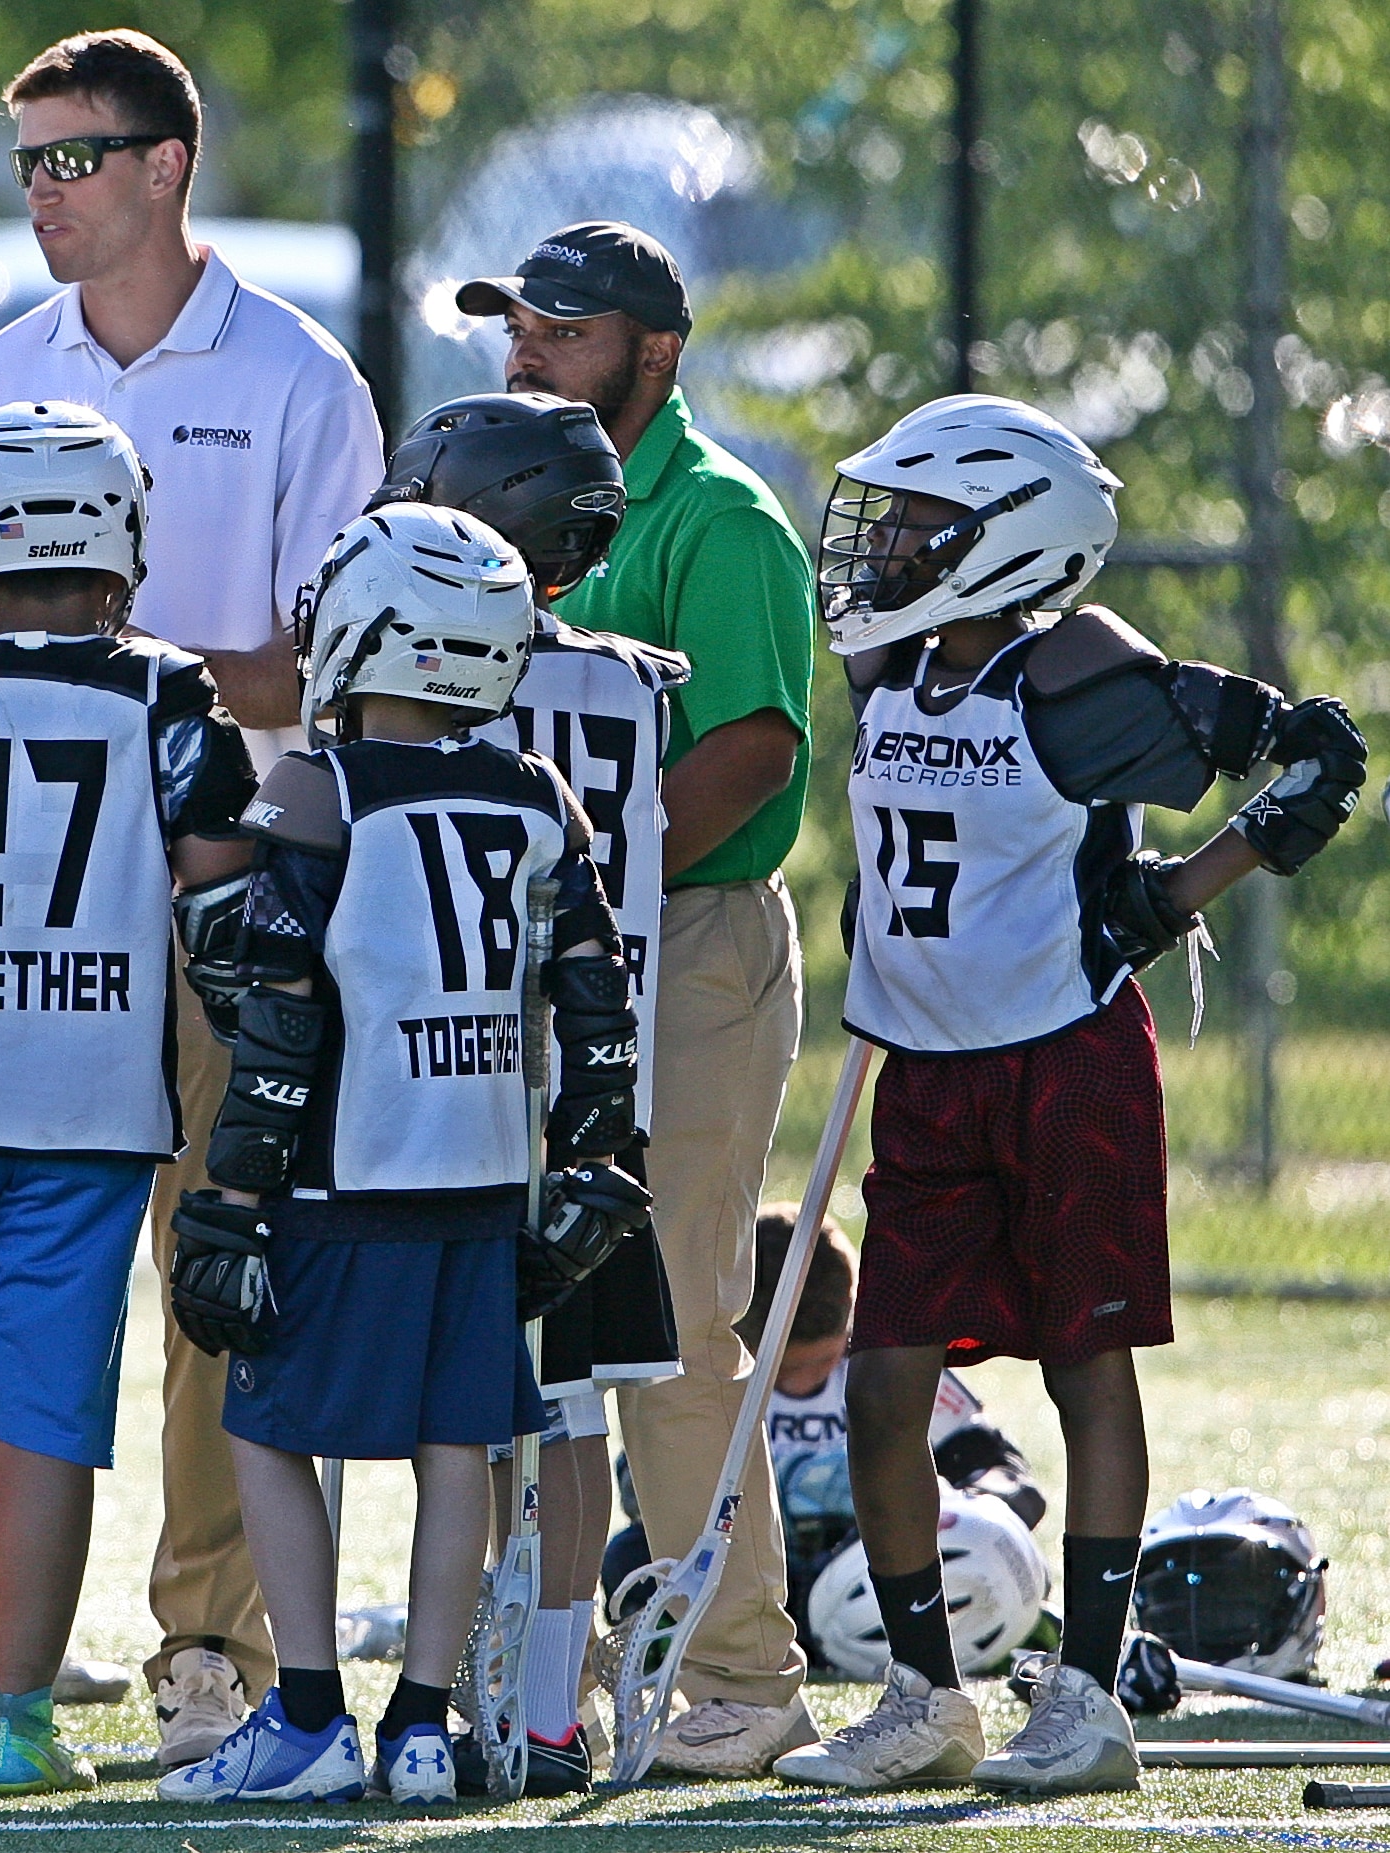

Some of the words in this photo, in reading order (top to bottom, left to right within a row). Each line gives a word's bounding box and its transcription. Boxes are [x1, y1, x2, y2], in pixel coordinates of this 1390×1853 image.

[191, 427, 253, 443] BRONX
[28, 539, 87, 557] schutt
[929, 525, 958, 550] STX
[422, 681, 481, 699] schutt
[871, 731, 1021, 769] BRONX
[868, 761, 1022, 786] LACROSSE
[241, 800, 285, 828] NIKE
[872, 805, 960, 939] 15
[405, 812, 529, 992] 18
[587, 1036, 638, 1067] STX
[250, 1075, 310, 1107] STX
